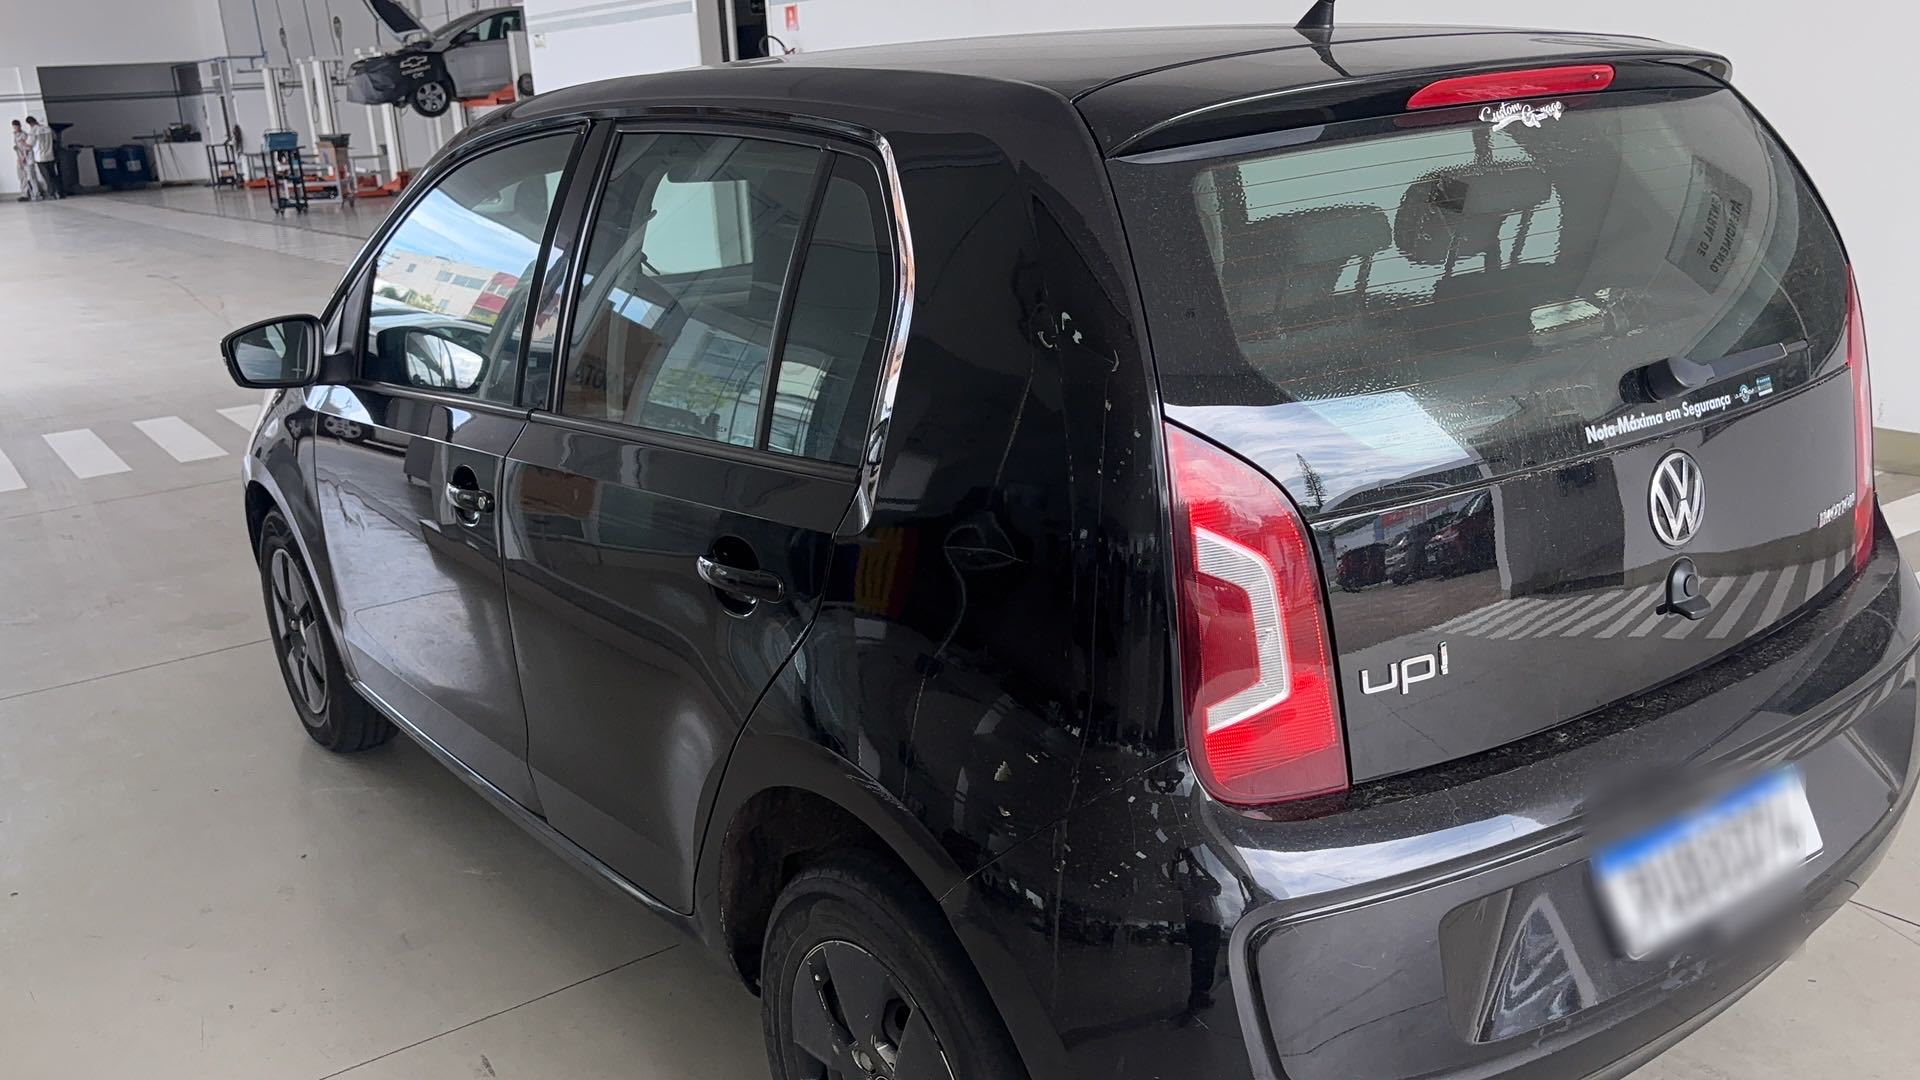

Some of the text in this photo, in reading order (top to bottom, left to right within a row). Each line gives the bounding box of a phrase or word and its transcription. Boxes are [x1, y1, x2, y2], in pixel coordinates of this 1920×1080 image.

[1479, 101, 1562, 128] Custom Grage
[1584, 394, 1732, 445] Nota Máxima em Segurança
[1359, 641, 1449, 695] up!
